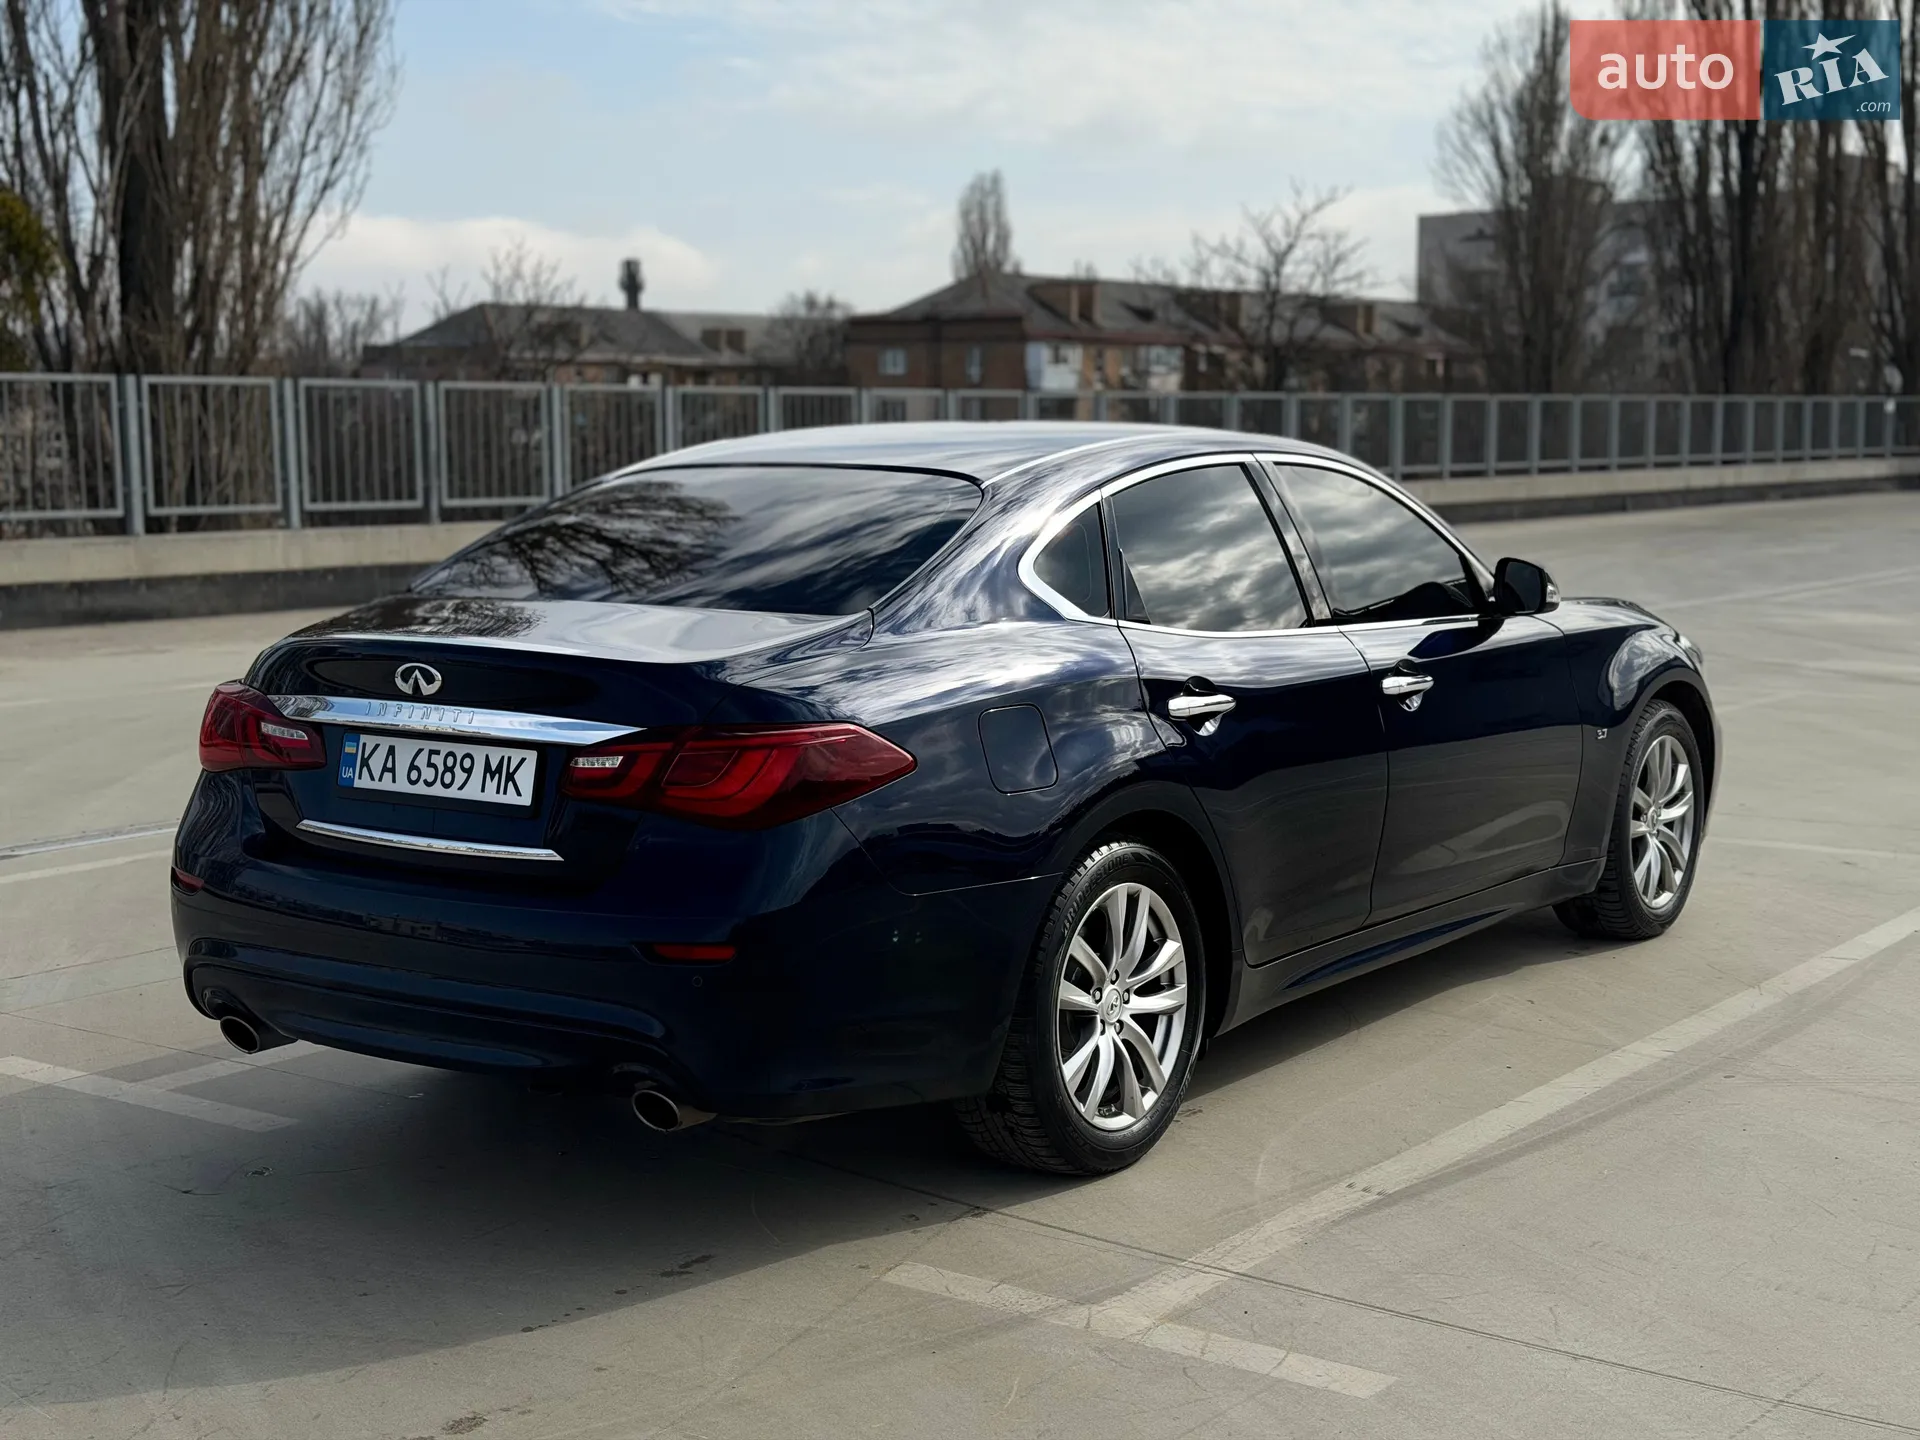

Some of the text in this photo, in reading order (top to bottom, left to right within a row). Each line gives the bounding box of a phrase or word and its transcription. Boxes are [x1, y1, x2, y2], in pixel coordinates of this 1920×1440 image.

[365, 701, 475, 725] INFINITI
[341, 766, 354, 779] UA
[358, 742, 527, 797] KA 6589 MK
[1061, 852, 1131, 938] BRIDGESTONE
